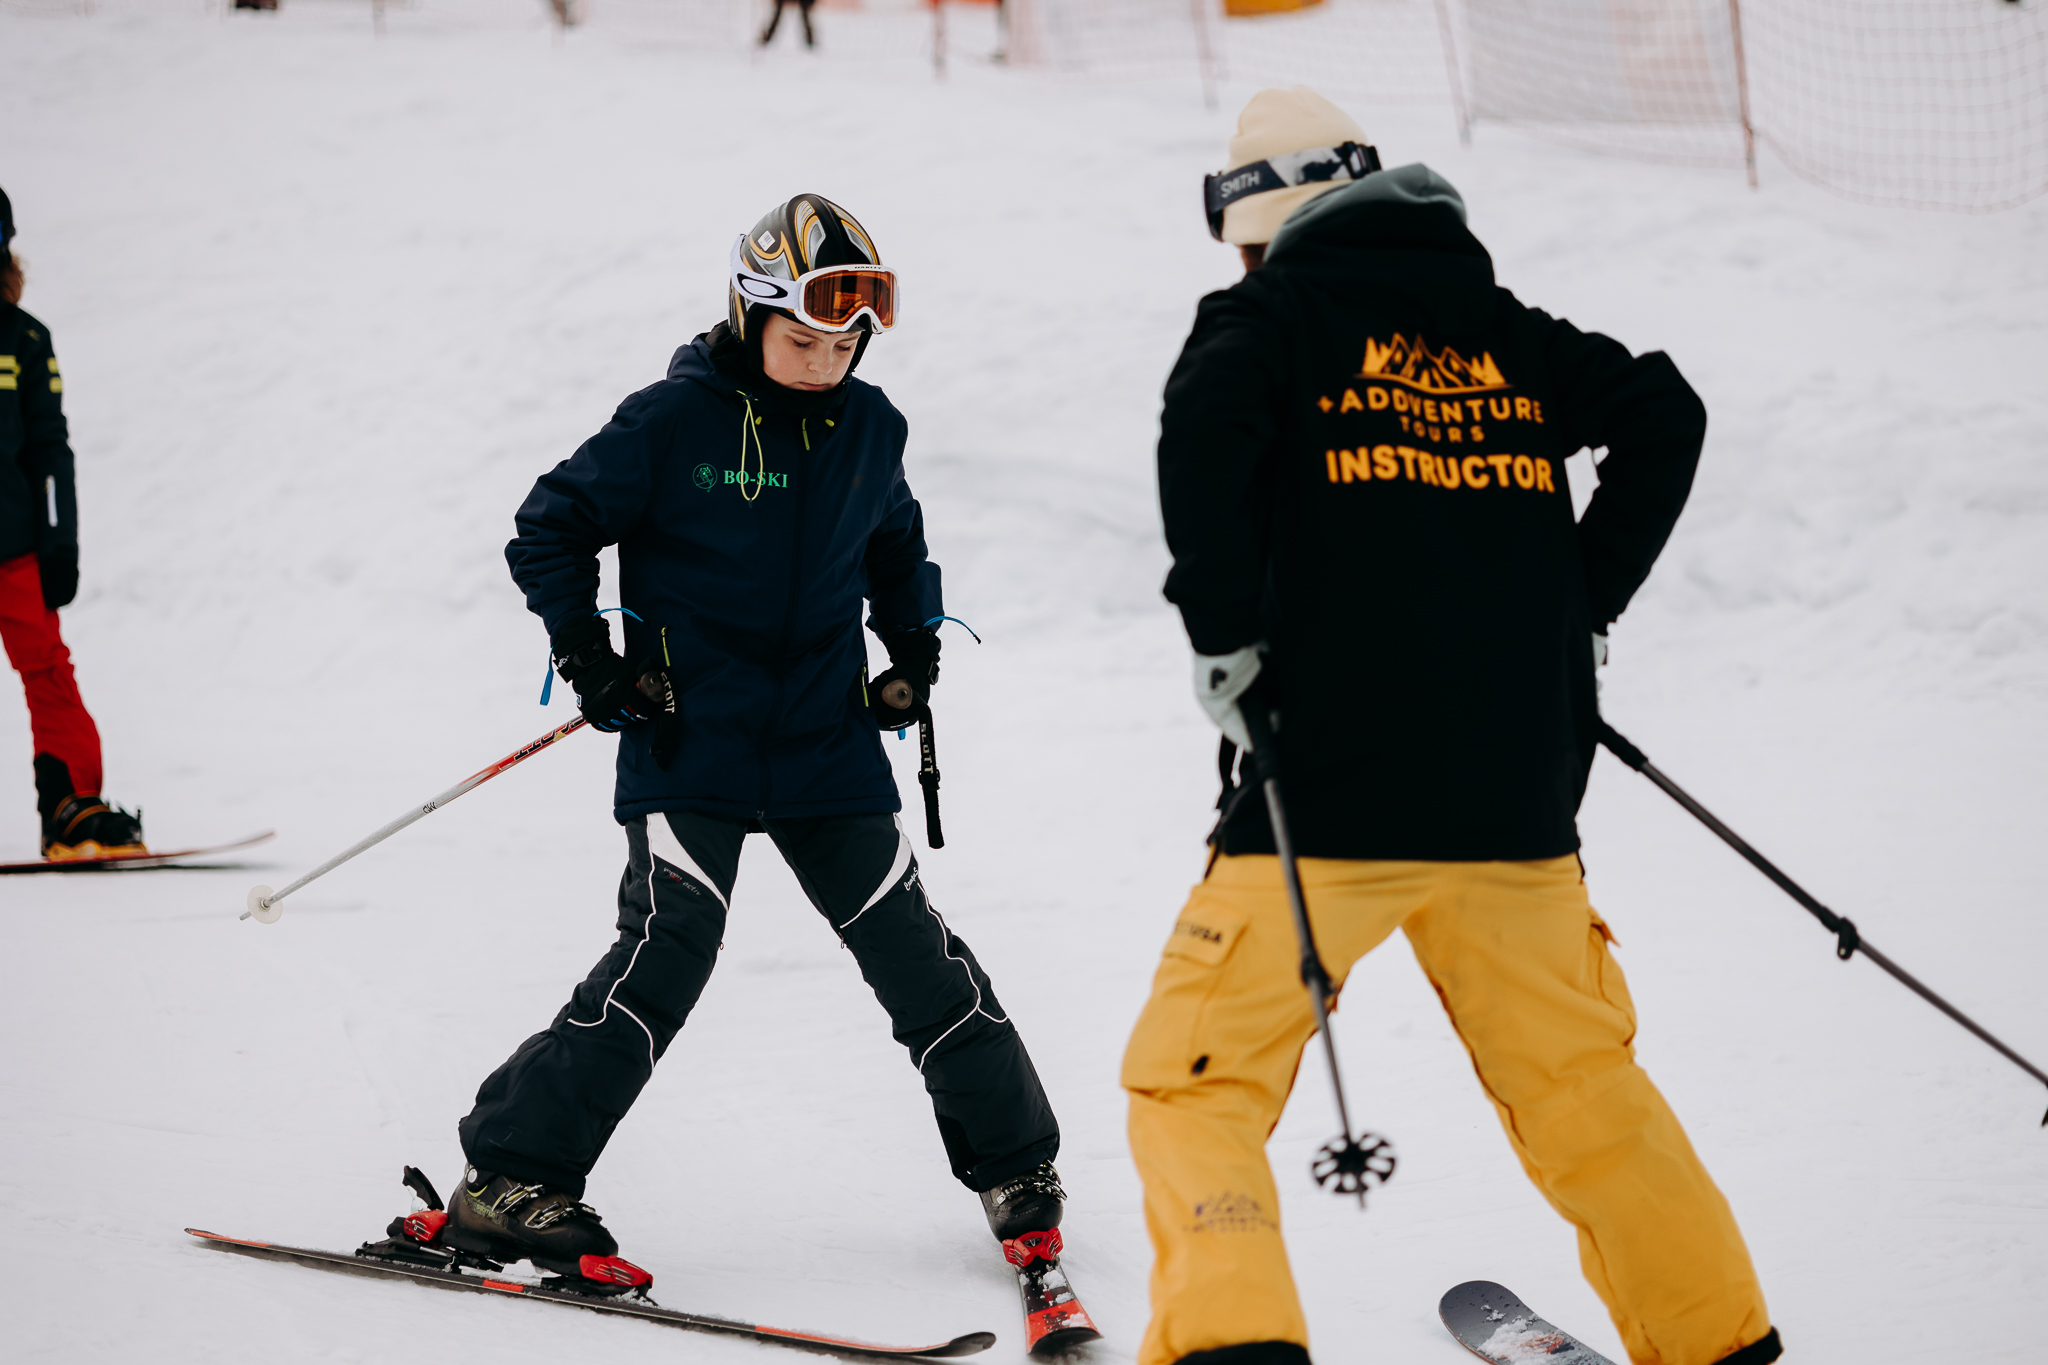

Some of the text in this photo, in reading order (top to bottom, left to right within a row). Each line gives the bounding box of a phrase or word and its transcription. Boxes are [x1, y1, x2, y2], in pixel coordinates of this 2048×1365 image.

[1220, 171, 1261, 199] SMITH
[1400, 415, 1485, 443] TOURS
[723, 469, 788, 488] BO-SKI
[1325, 444, 1556, 493] INSTRUCTOR
